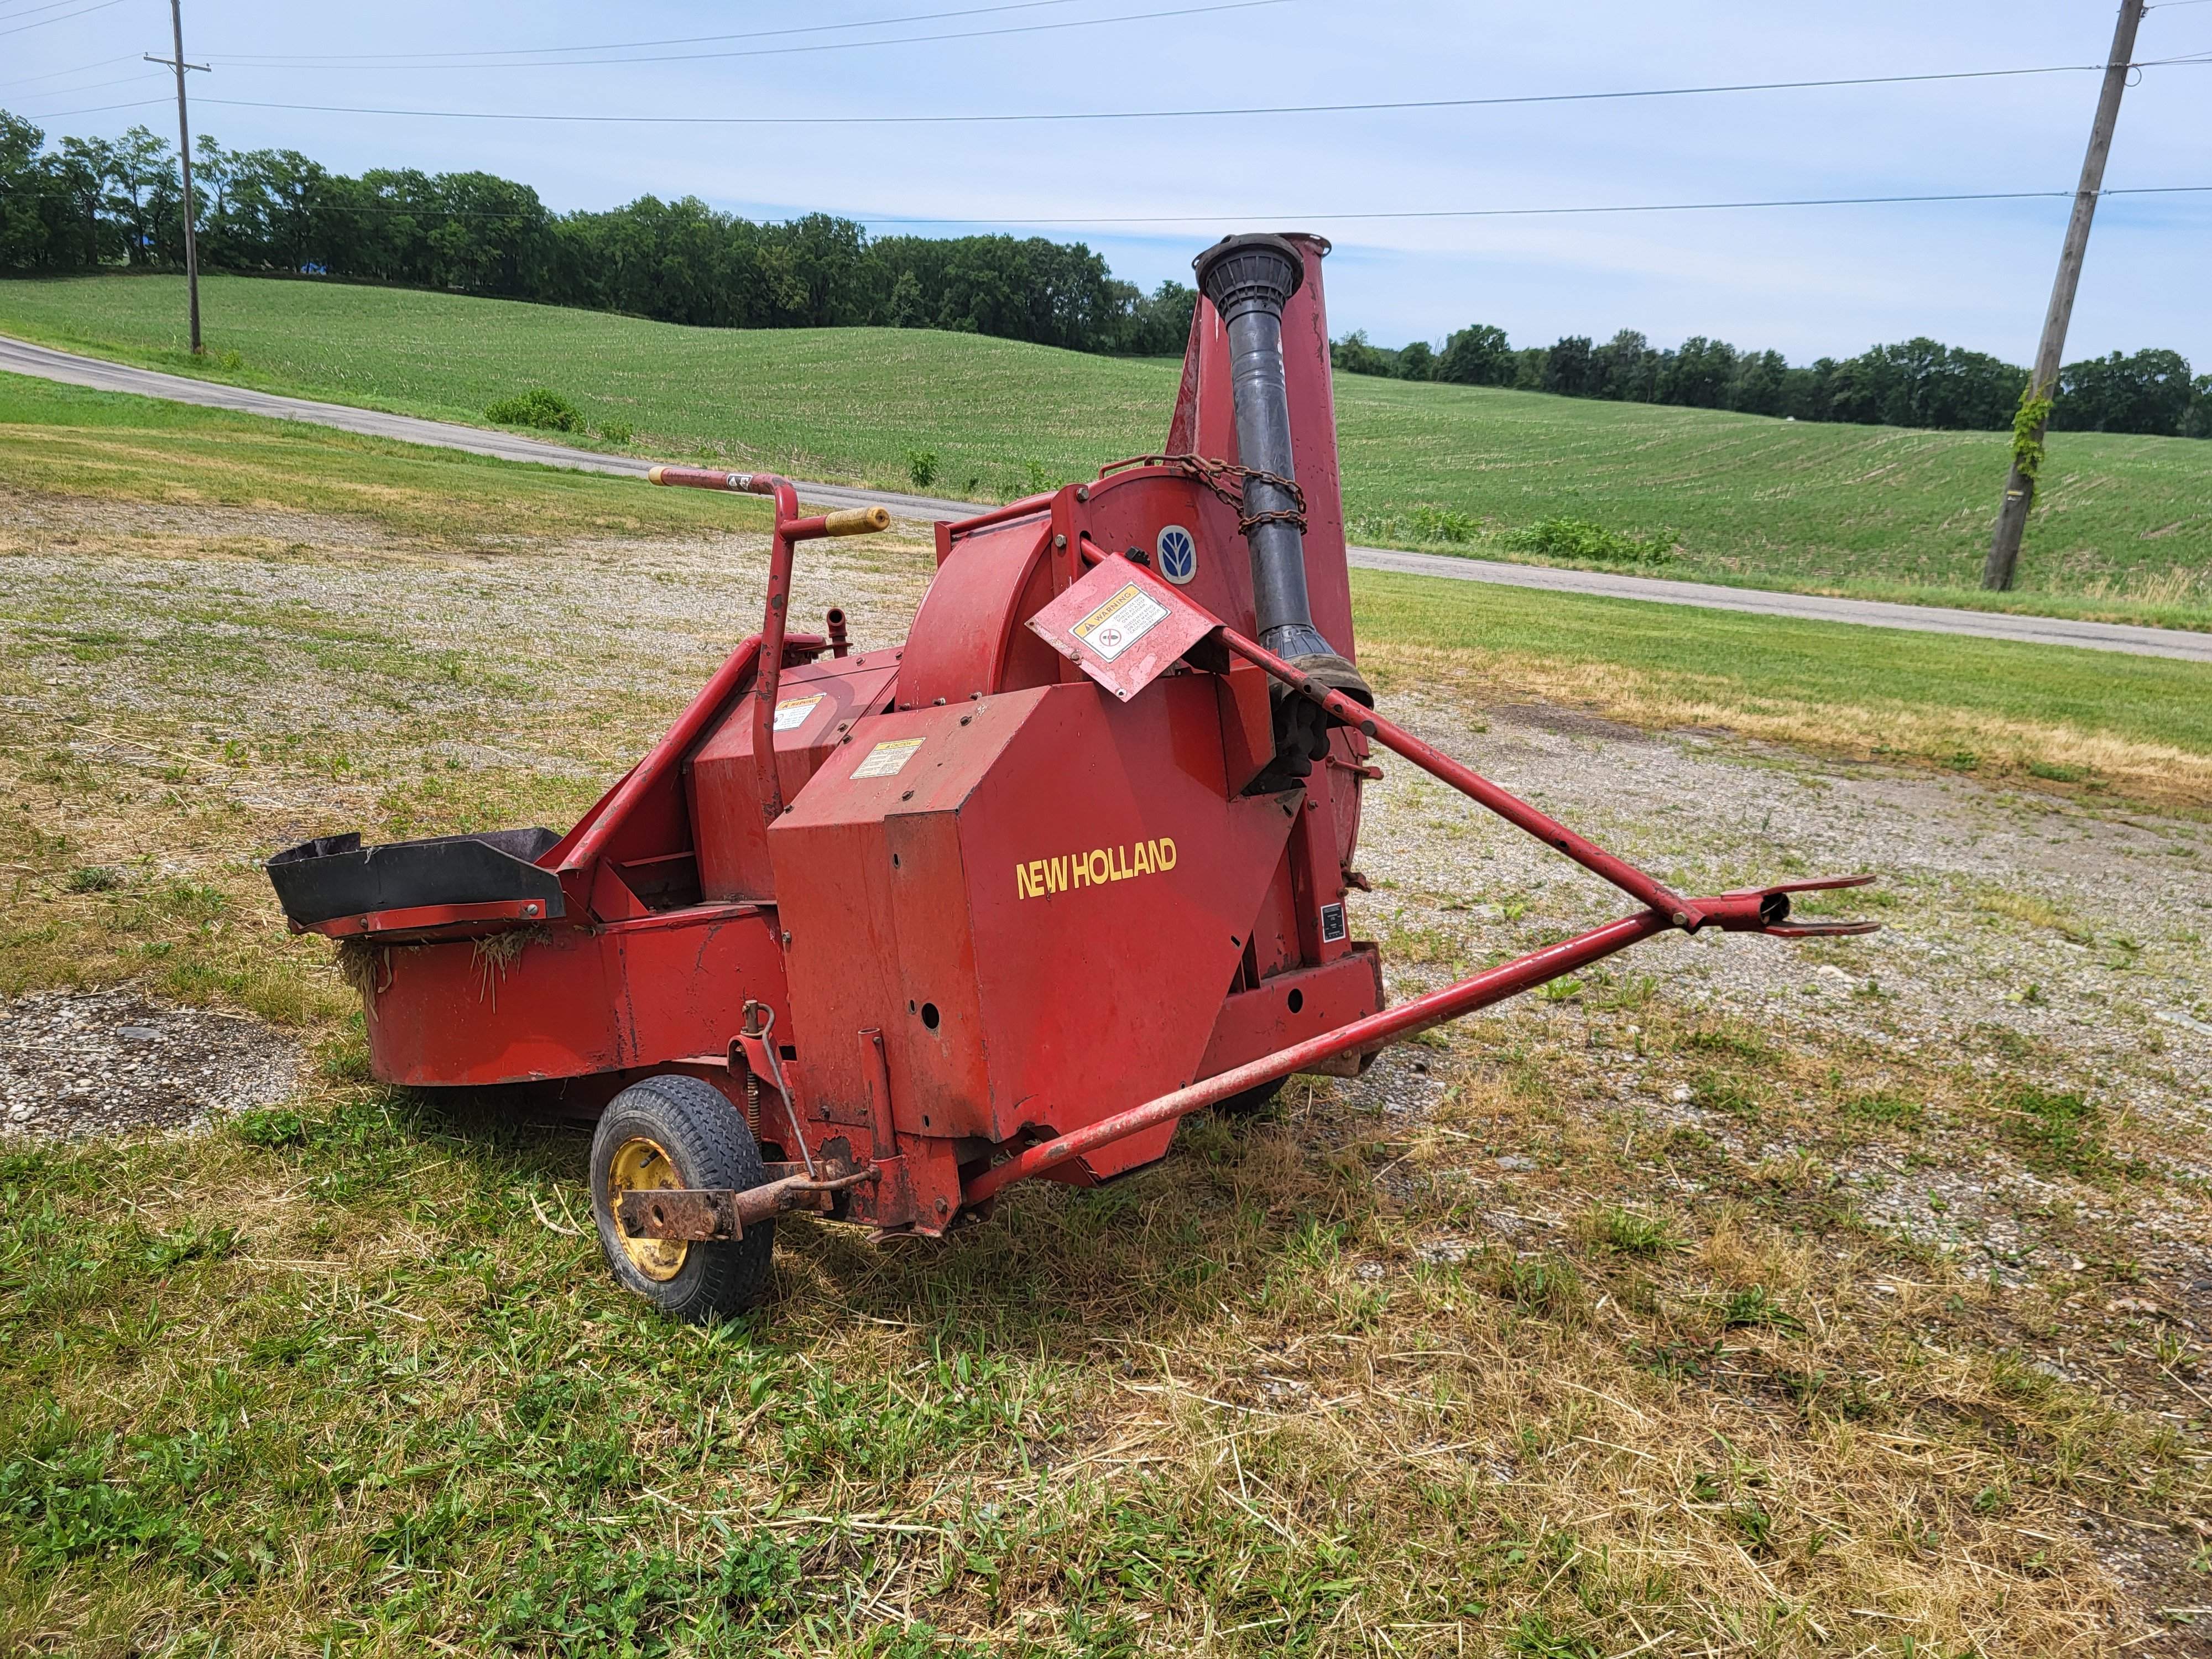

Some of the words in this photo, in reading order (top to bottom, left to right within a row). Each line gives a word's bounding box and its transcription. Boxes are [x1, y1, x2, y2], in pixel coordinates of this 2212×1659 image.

[1094, 592, 1131, 621] WARNING
[1016, 855, 1067, 900] NEW
[1071, 837, 1177, 889] HOLLAND
